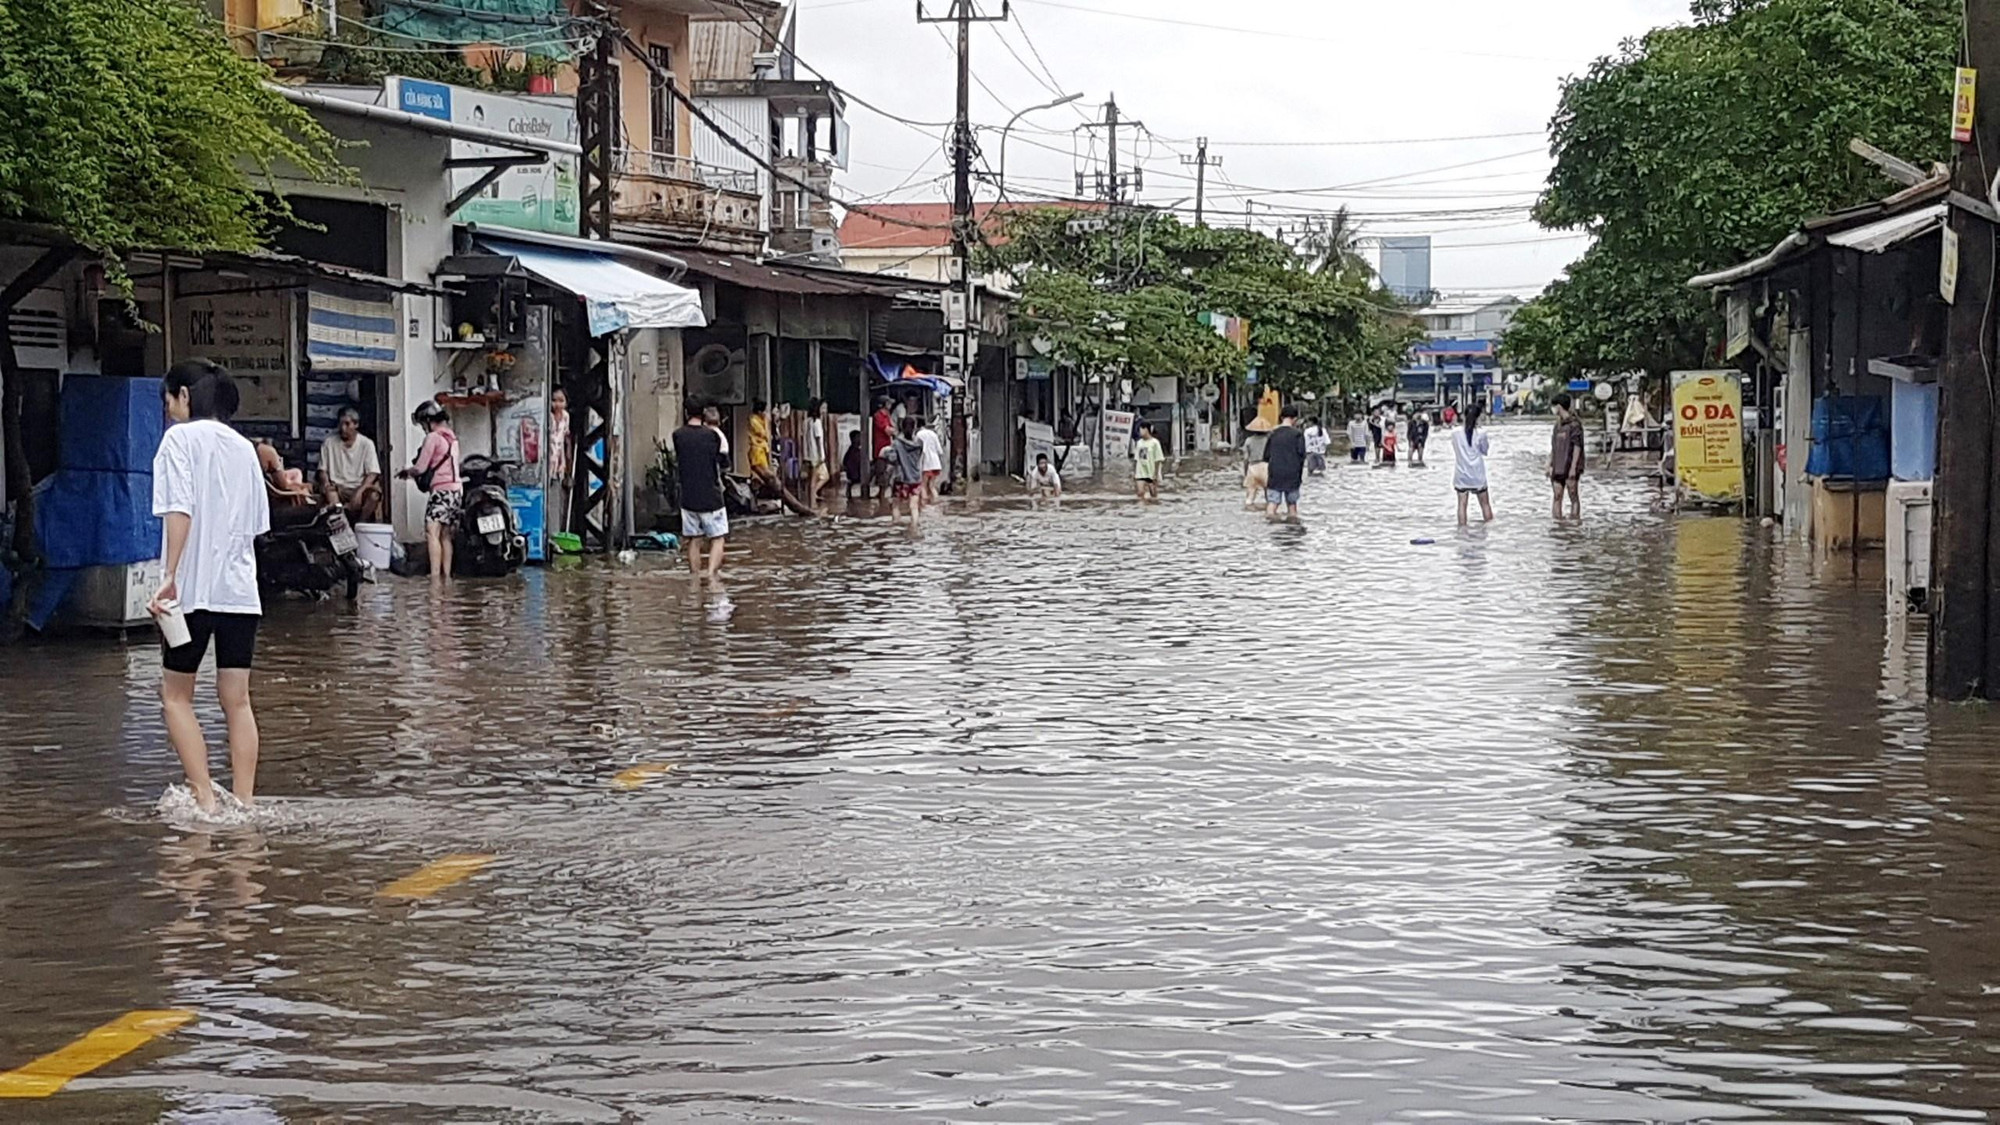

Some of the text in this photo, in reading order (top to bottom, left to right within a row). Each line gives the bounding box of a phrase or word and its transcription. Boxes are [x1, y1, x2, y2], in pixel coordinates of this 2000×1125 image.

[190, 299, 215, 346] CHÈ
[1681, 403, 1735, 420] O ĐA
[1680, 424, 1702, 435] BÚN
